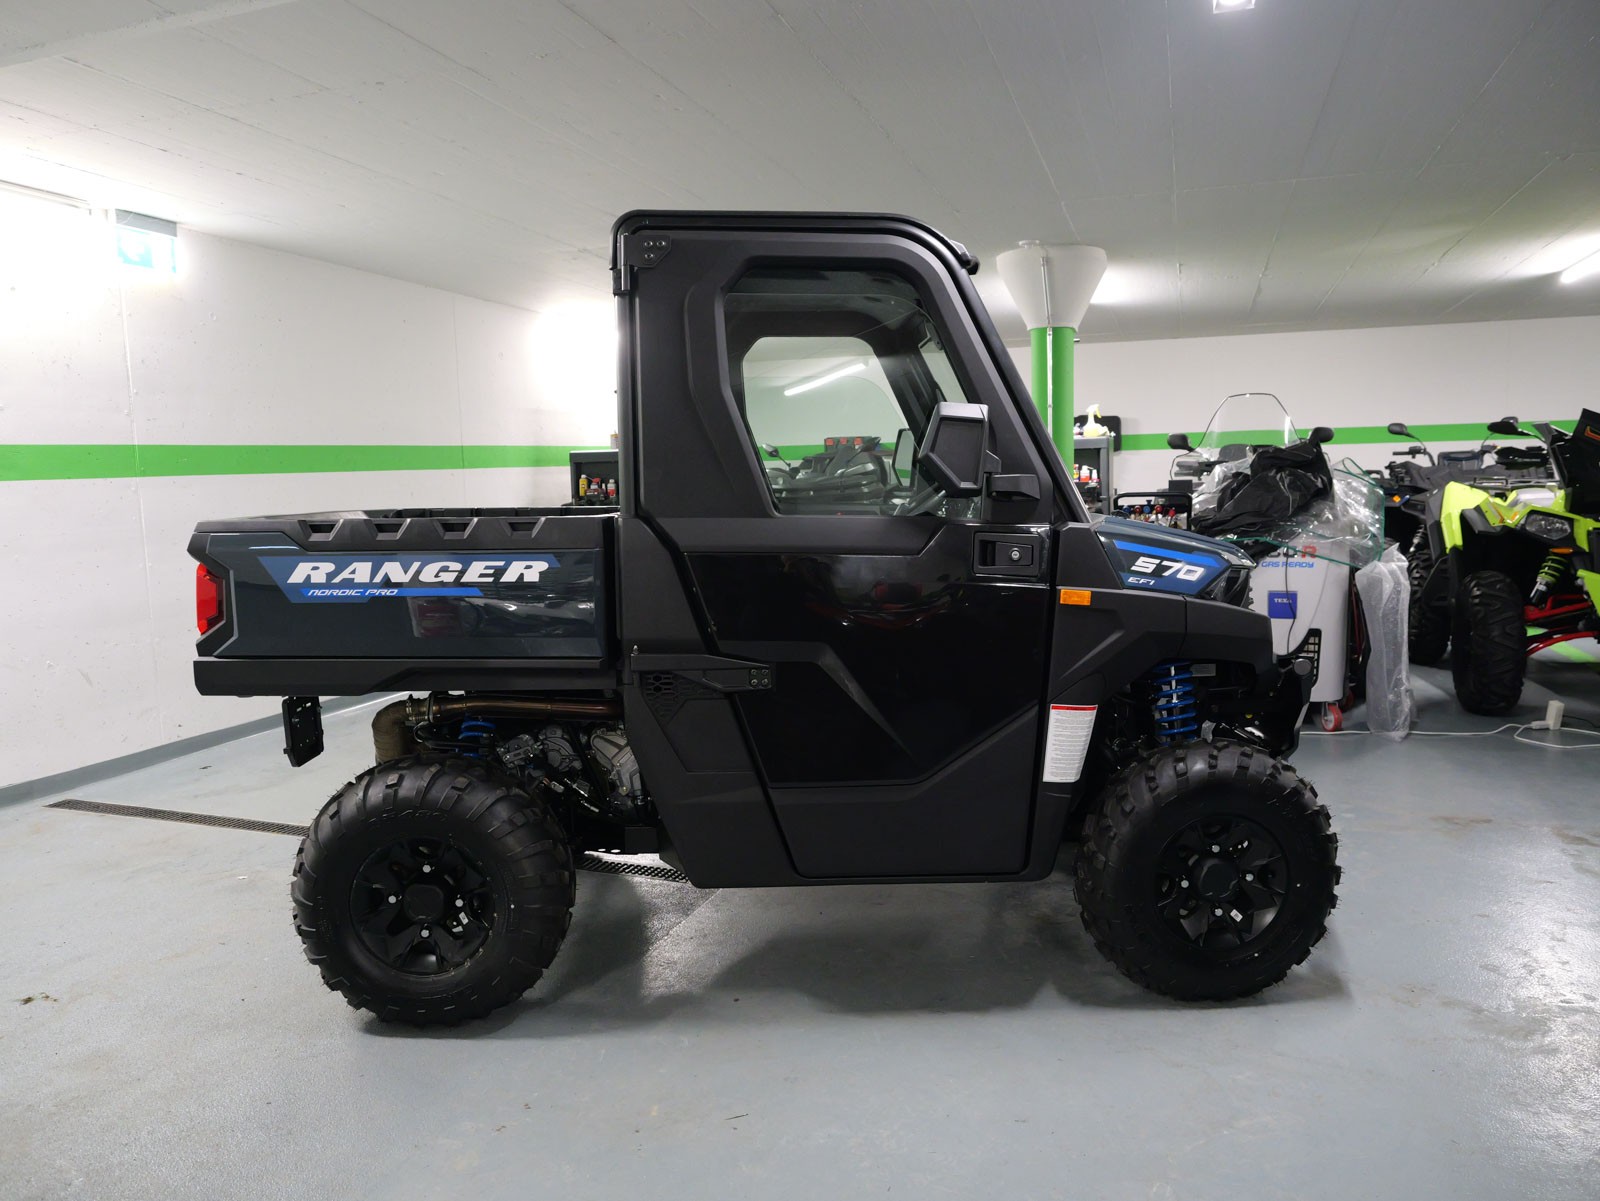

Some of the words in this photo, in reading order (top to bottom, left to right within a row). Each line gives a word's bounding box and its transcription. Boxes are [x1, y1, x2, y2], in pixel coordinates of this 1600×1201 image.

[286, 560, 549, 584] RANGER
[1130, 556, 1205, 581] 570
[1127, 576, 1156, 586] EFI
